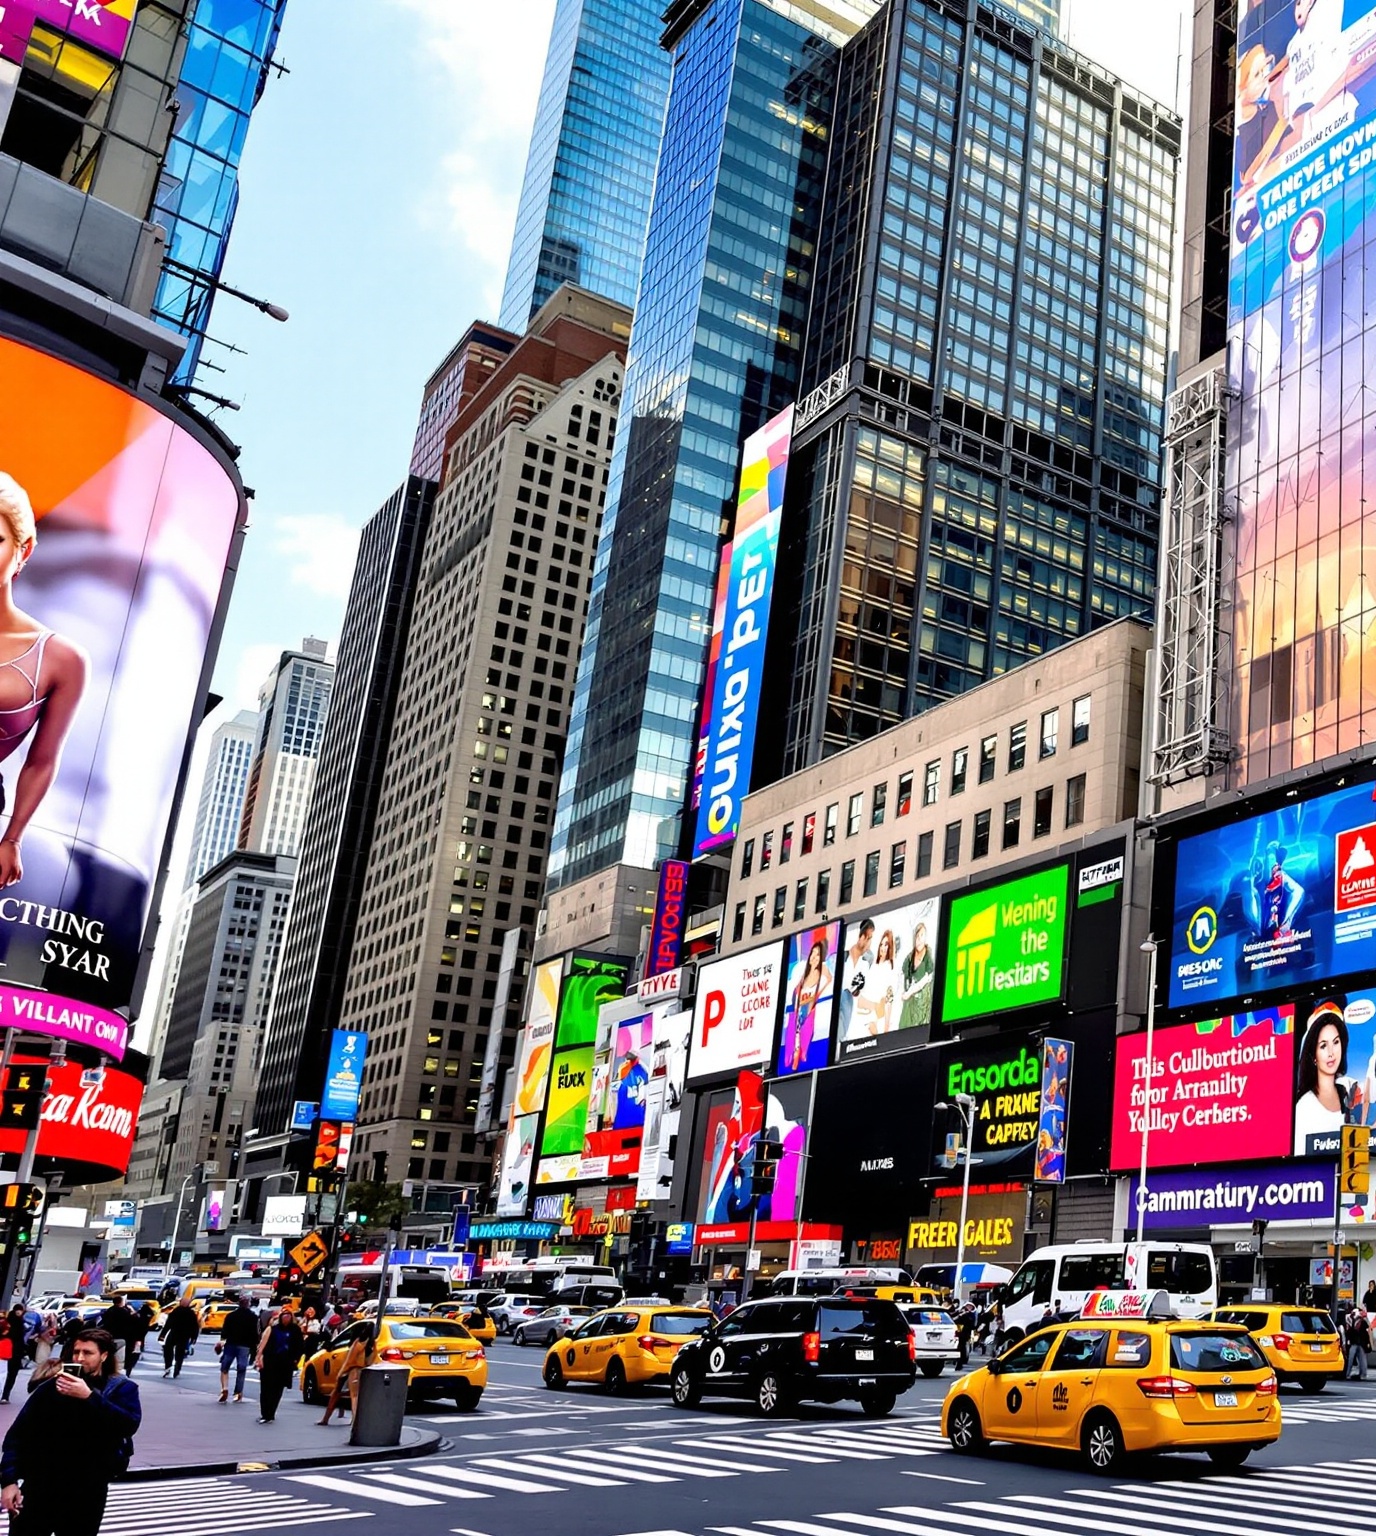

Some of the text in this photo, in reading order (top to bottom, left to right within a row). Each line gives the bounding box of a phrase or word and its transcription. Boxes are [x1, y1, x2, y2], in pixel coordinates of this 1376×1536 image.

[1021, 929, 1048, 953] the
[40, 939, 110, 982] SYAR
[13, 996, 95, 1034] VILLANT
[948, 1048, 1040, 1096] Ensorda
[1132, 1056, 1165, 1080] This
[979, 1097, 991, 1121] A
